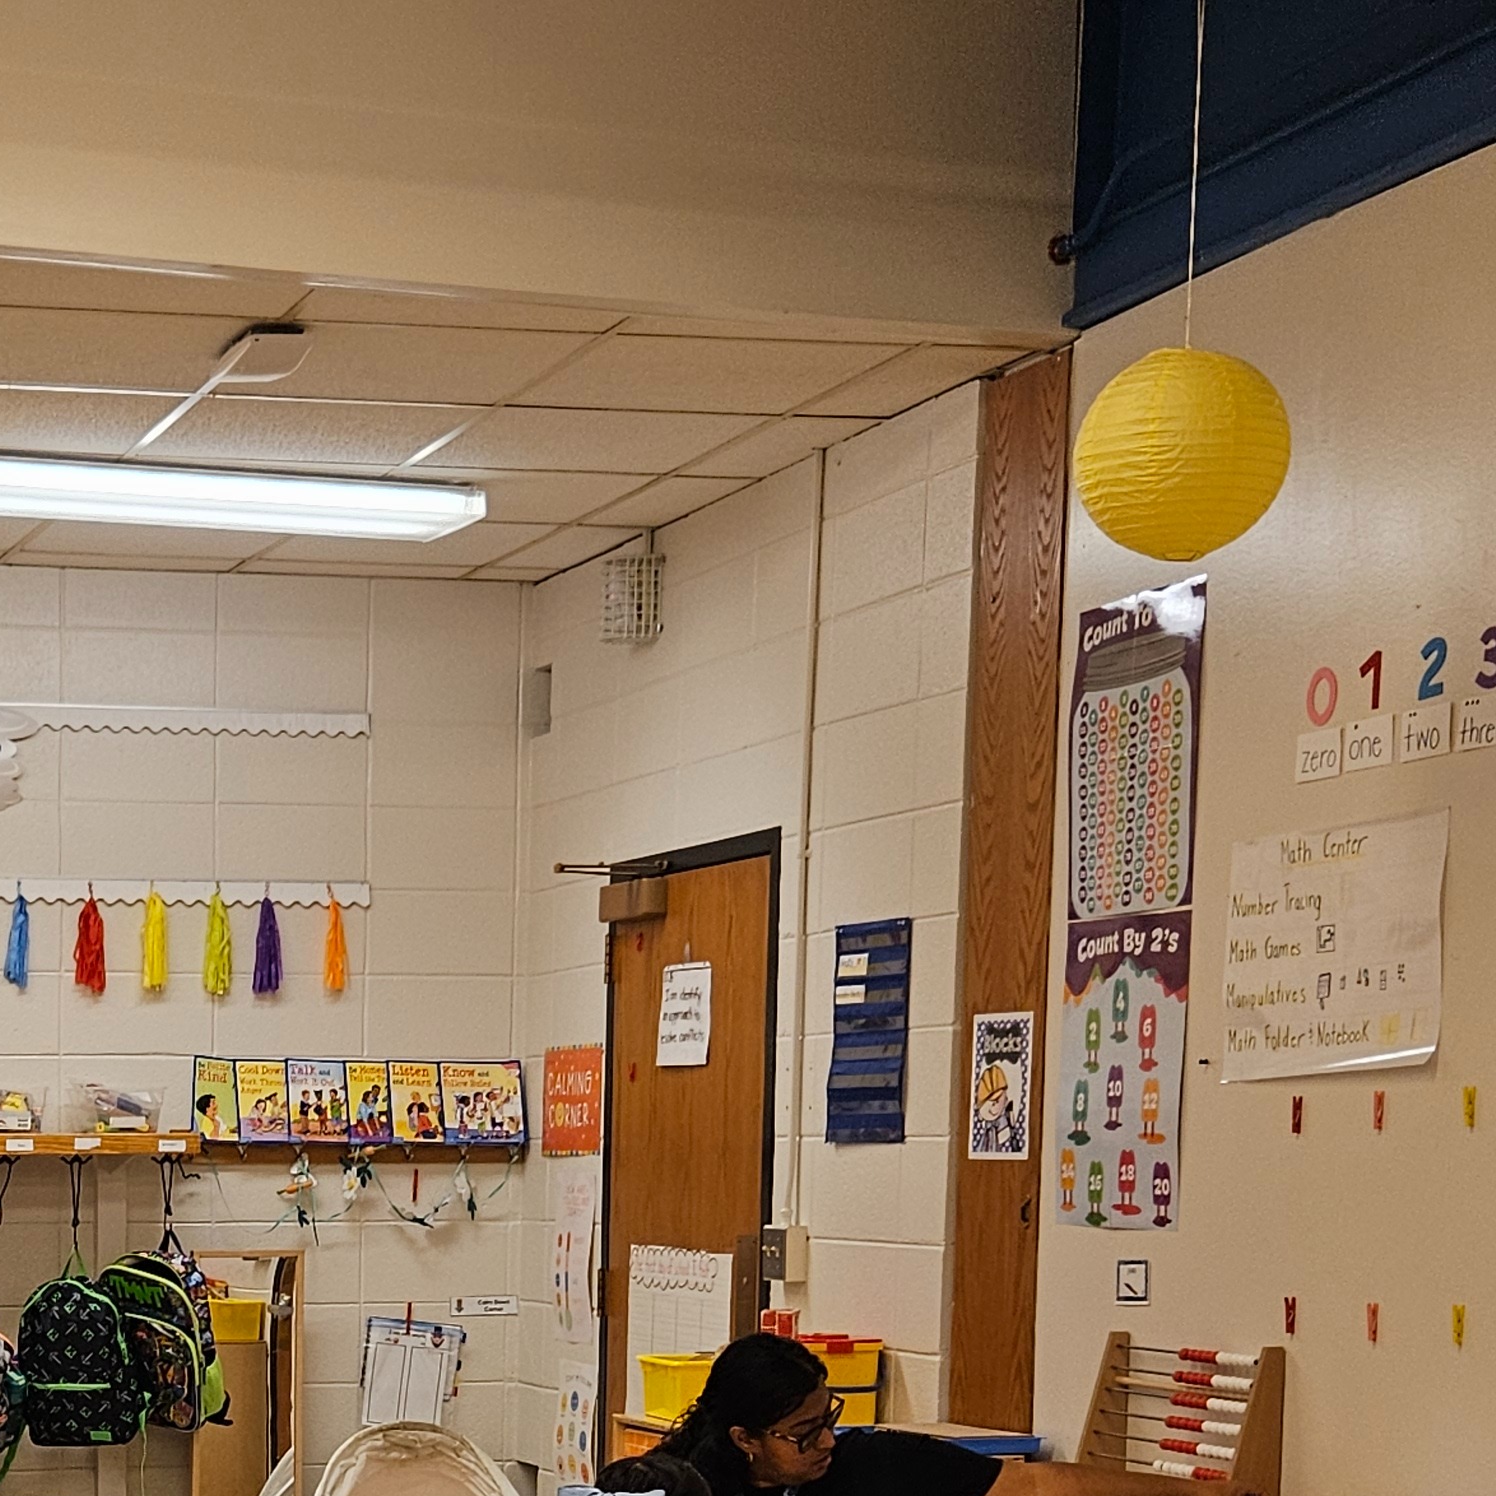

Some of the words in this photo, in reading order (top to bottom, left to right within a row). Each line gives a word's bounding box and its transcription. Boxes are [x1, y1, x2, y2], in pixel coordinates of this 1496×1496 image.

[1083, 612, 1129, 652] Count
[1306, 667, 1338, 727] 0
[1359, 650, 1382, 710] 1
[1418, 637, 1447, 700] 2
[1475, 626, 1496, 690] 3
[1404, 724, 1440, 752] two
[1460, 717, 1496, 745] thre
[1349, 735, 1382, 760] one
[1301, 749, 1337, 773] zero
[1281, 838, 1312, 864] Math
[1323, 831, 1368, 858] Center
[1232, 893, 1278, 918] Number
[1284, 882, 1322, 921] Tracing
[1078, 930, 1119, 962] Count
[1123, 927, 1146, 956] By
[1151, 926, 1180, 953] 2's
[1229, 940, 1256, 964] Math
[1265, 936, 1301, 960] Games
[1226, 981, 1306, 1010] Manipulatives
[1088, 1021, 1098, 1041] 2
[1142, 1017, 1152, 1037] 6
[1228, 1029, 1256, 1053] Math
[1265, 1024, 1305, 1050] Folder
[198, 1070, 227, 1084] Kind
[239, 1065, 259, 1075] Cool
[289, 1064, 316, 1076] Talk
[392, 1065, 429, 1077] Listen
[442, 1066, 476, 1077] Know
[547, 1070, 592, 1096] CALMING
[1108, 1080, 1122, 1097] 10
[1076, 1093, 1085, 1112] 8
[1143, 1093, 1158, 1109] 12
[1088, 1174, 1102, 1191] 16
[1119, 1164, 1135, 1181] 18
[1154, 1178, 1170, 1195] 20
[109, 1275, 164, 1308] TMNT
